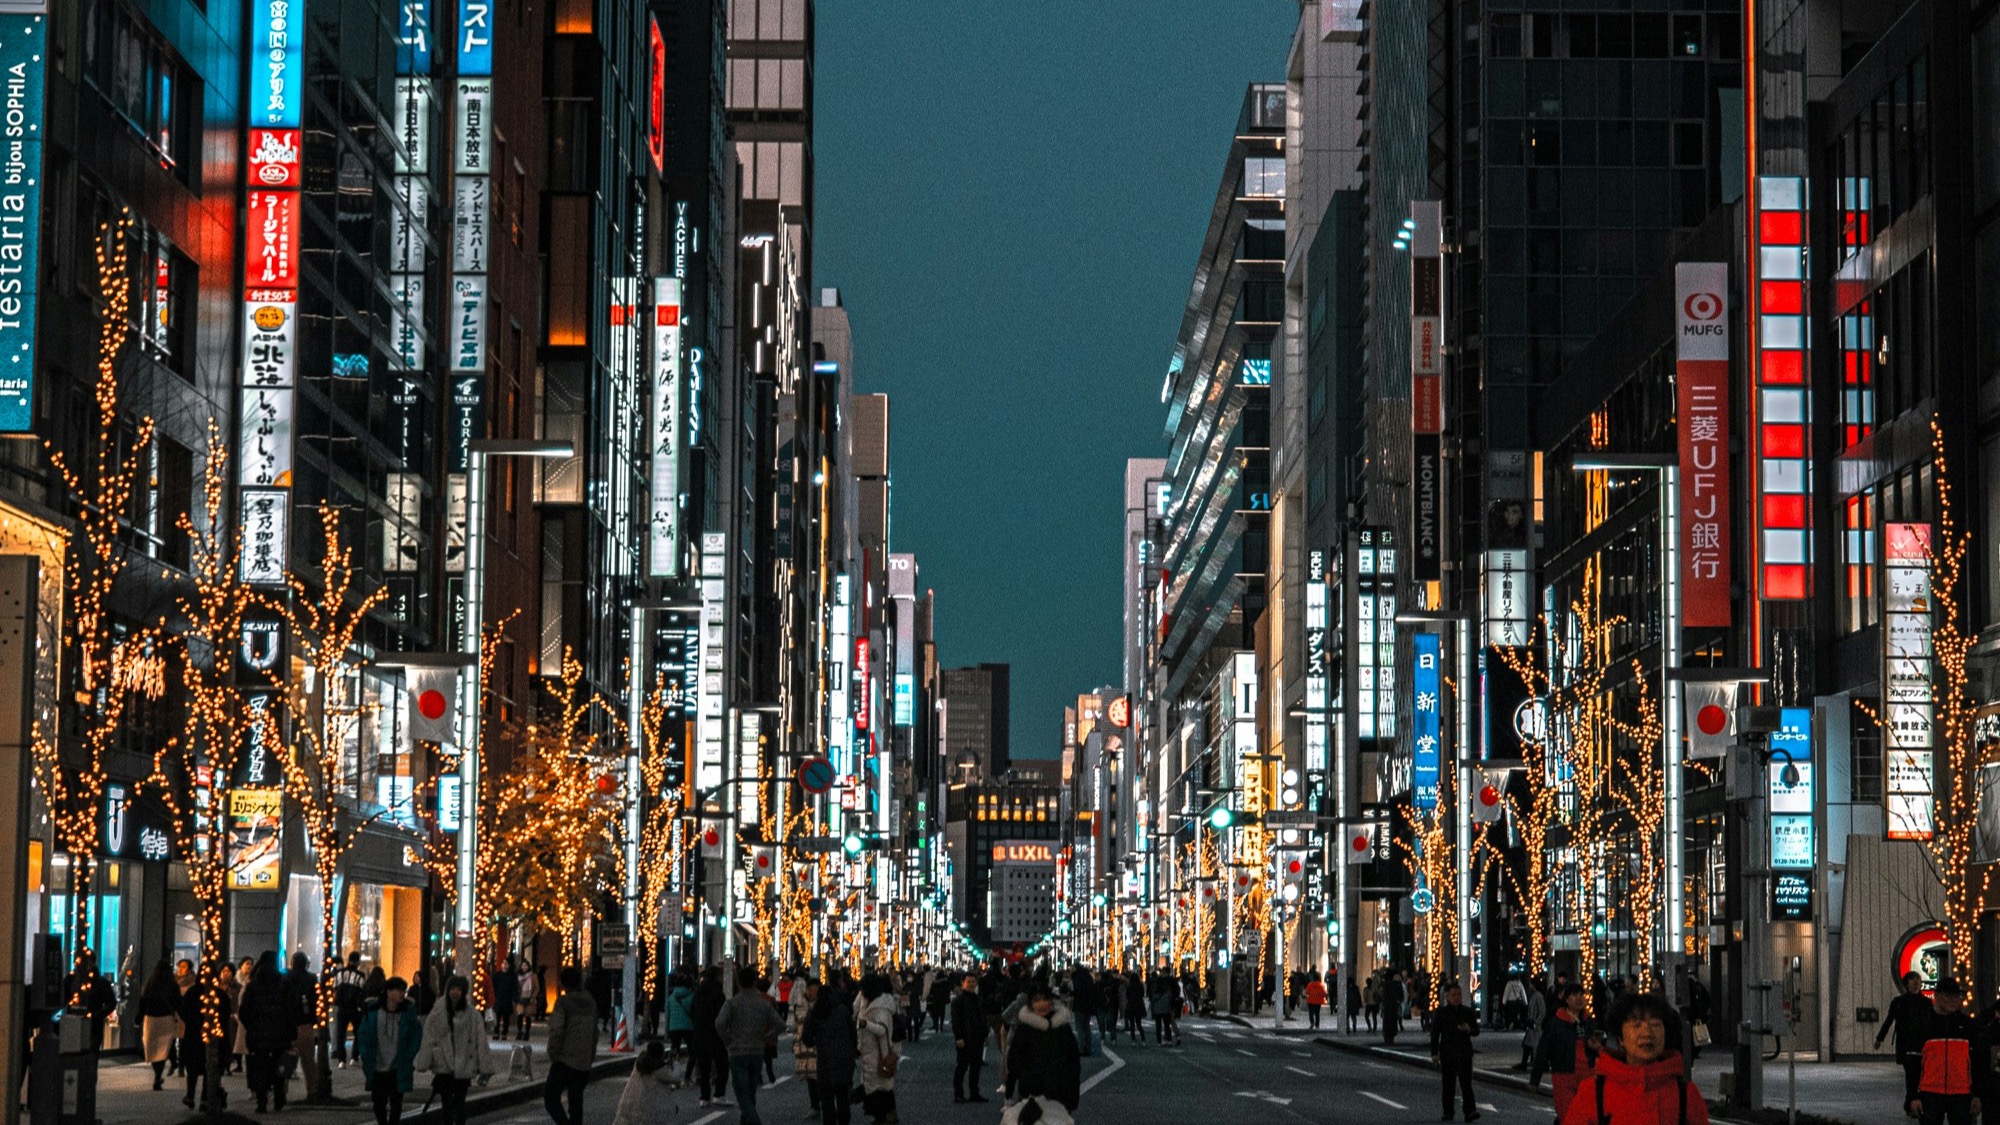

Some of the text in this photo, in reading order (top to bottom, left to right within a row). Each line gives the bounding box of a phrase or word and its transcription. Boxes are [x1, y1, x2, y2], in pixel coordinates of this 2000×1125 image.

[5, 62, 26, 185] bijou SOPHIA
[470, 86, 489, 94] MBC
[466, 99, 482, 168] 南日本放送
[261, 194, 278, 282] ラージマハール
[456, 189, 466, 258] LAND ESPACE
[470, 177, 483, 271] ランドエスパース
[251, 344, 284, 385] 北海
[459, 301, 479, 367] テレビ宮崎
[1684, 325, 1723, 336] MUFG
[256, 391, 278, 485] しゃぶしゃぶ
[1421, 455, 1433, 547] MONTBLANC
[1691, 386, 1720, 579] 三菱UFJ銀行
[251, 498, 274, 573] 星乃珈琲店
[1502, 552, 1513, 644] 三井不動産リアルティ
[686, 627, 698, 712] DAMIANI
[1309, 631, 1323, 674] ダンス
[1416, 653, 1437, 754] 日新堂
[1008, 845, 1052, 860] LIXIL
